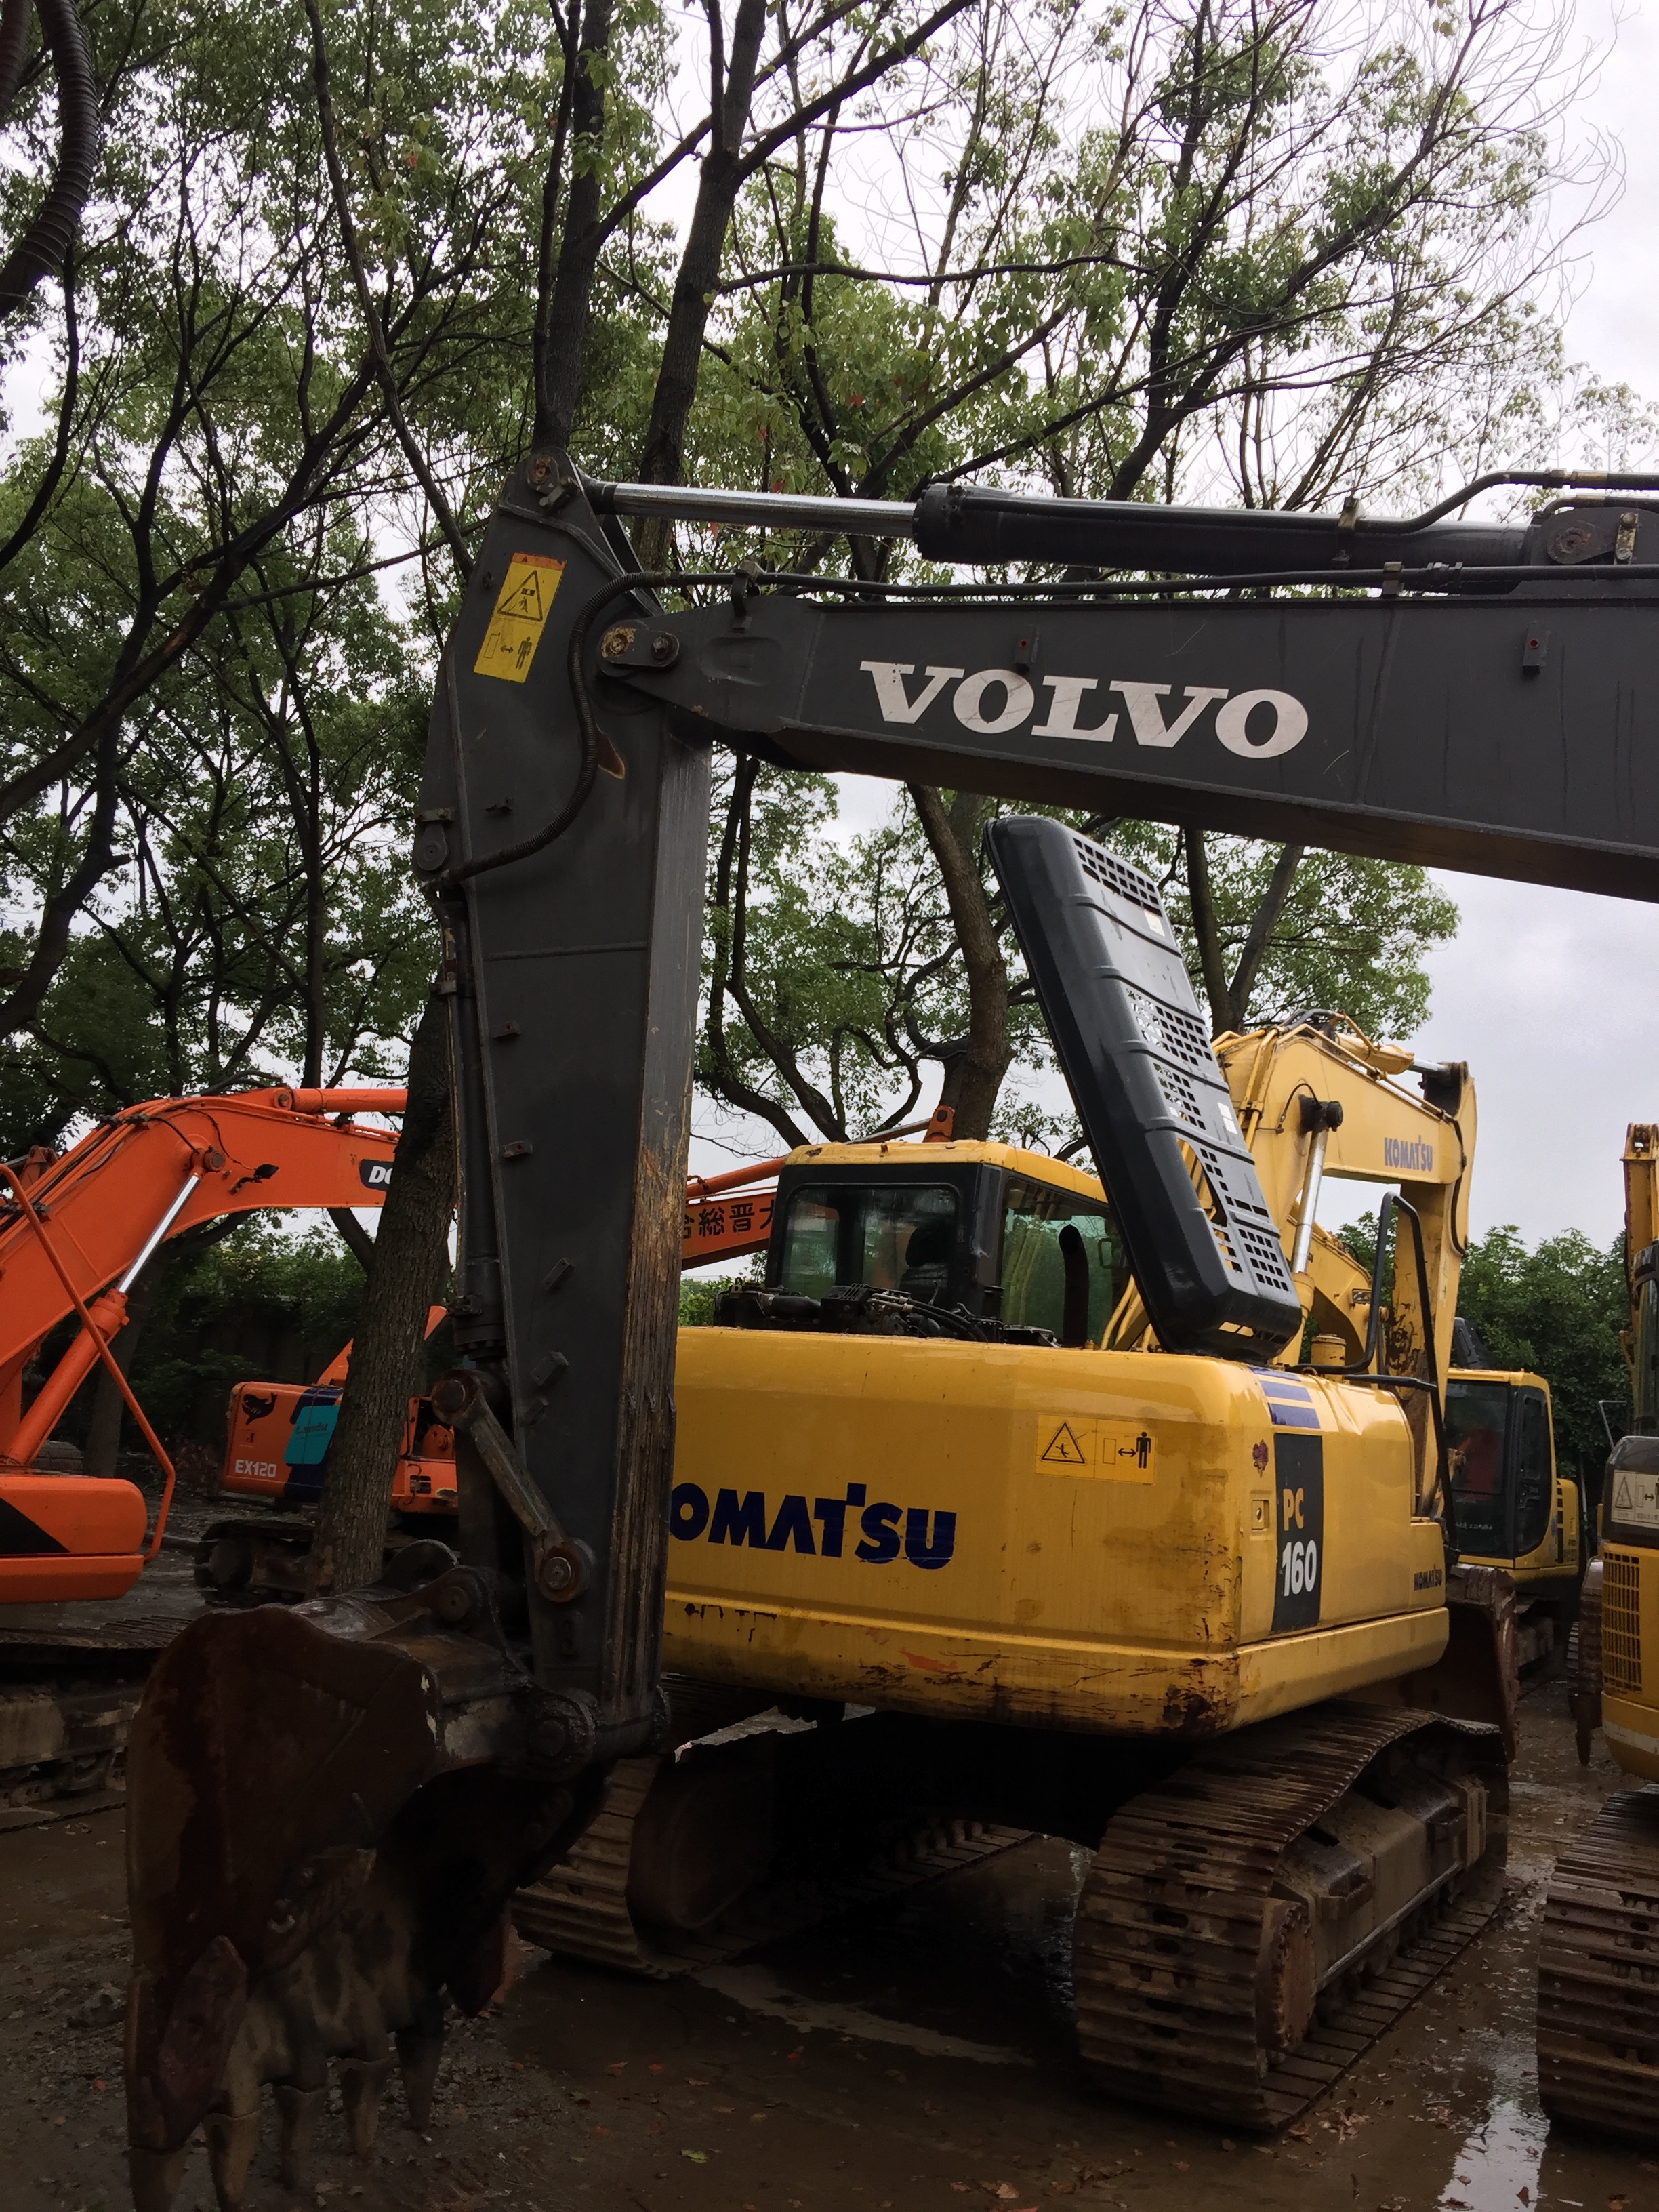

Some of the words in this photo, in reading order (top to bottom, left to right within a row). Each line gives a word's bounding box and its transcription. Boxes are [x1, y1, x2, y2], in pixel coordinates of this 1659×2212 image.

[859, 660, 1309, 759] VOLVO
[1384, 1135, 1433, 1172] KOMATSU
[234, 1459, 276, 1478] EX120
[670, 1482, 957, 1570] OMATSU
[1283, 1488, 1304, 1531] PC
[1282, 1540, 1317, 1597] 160
